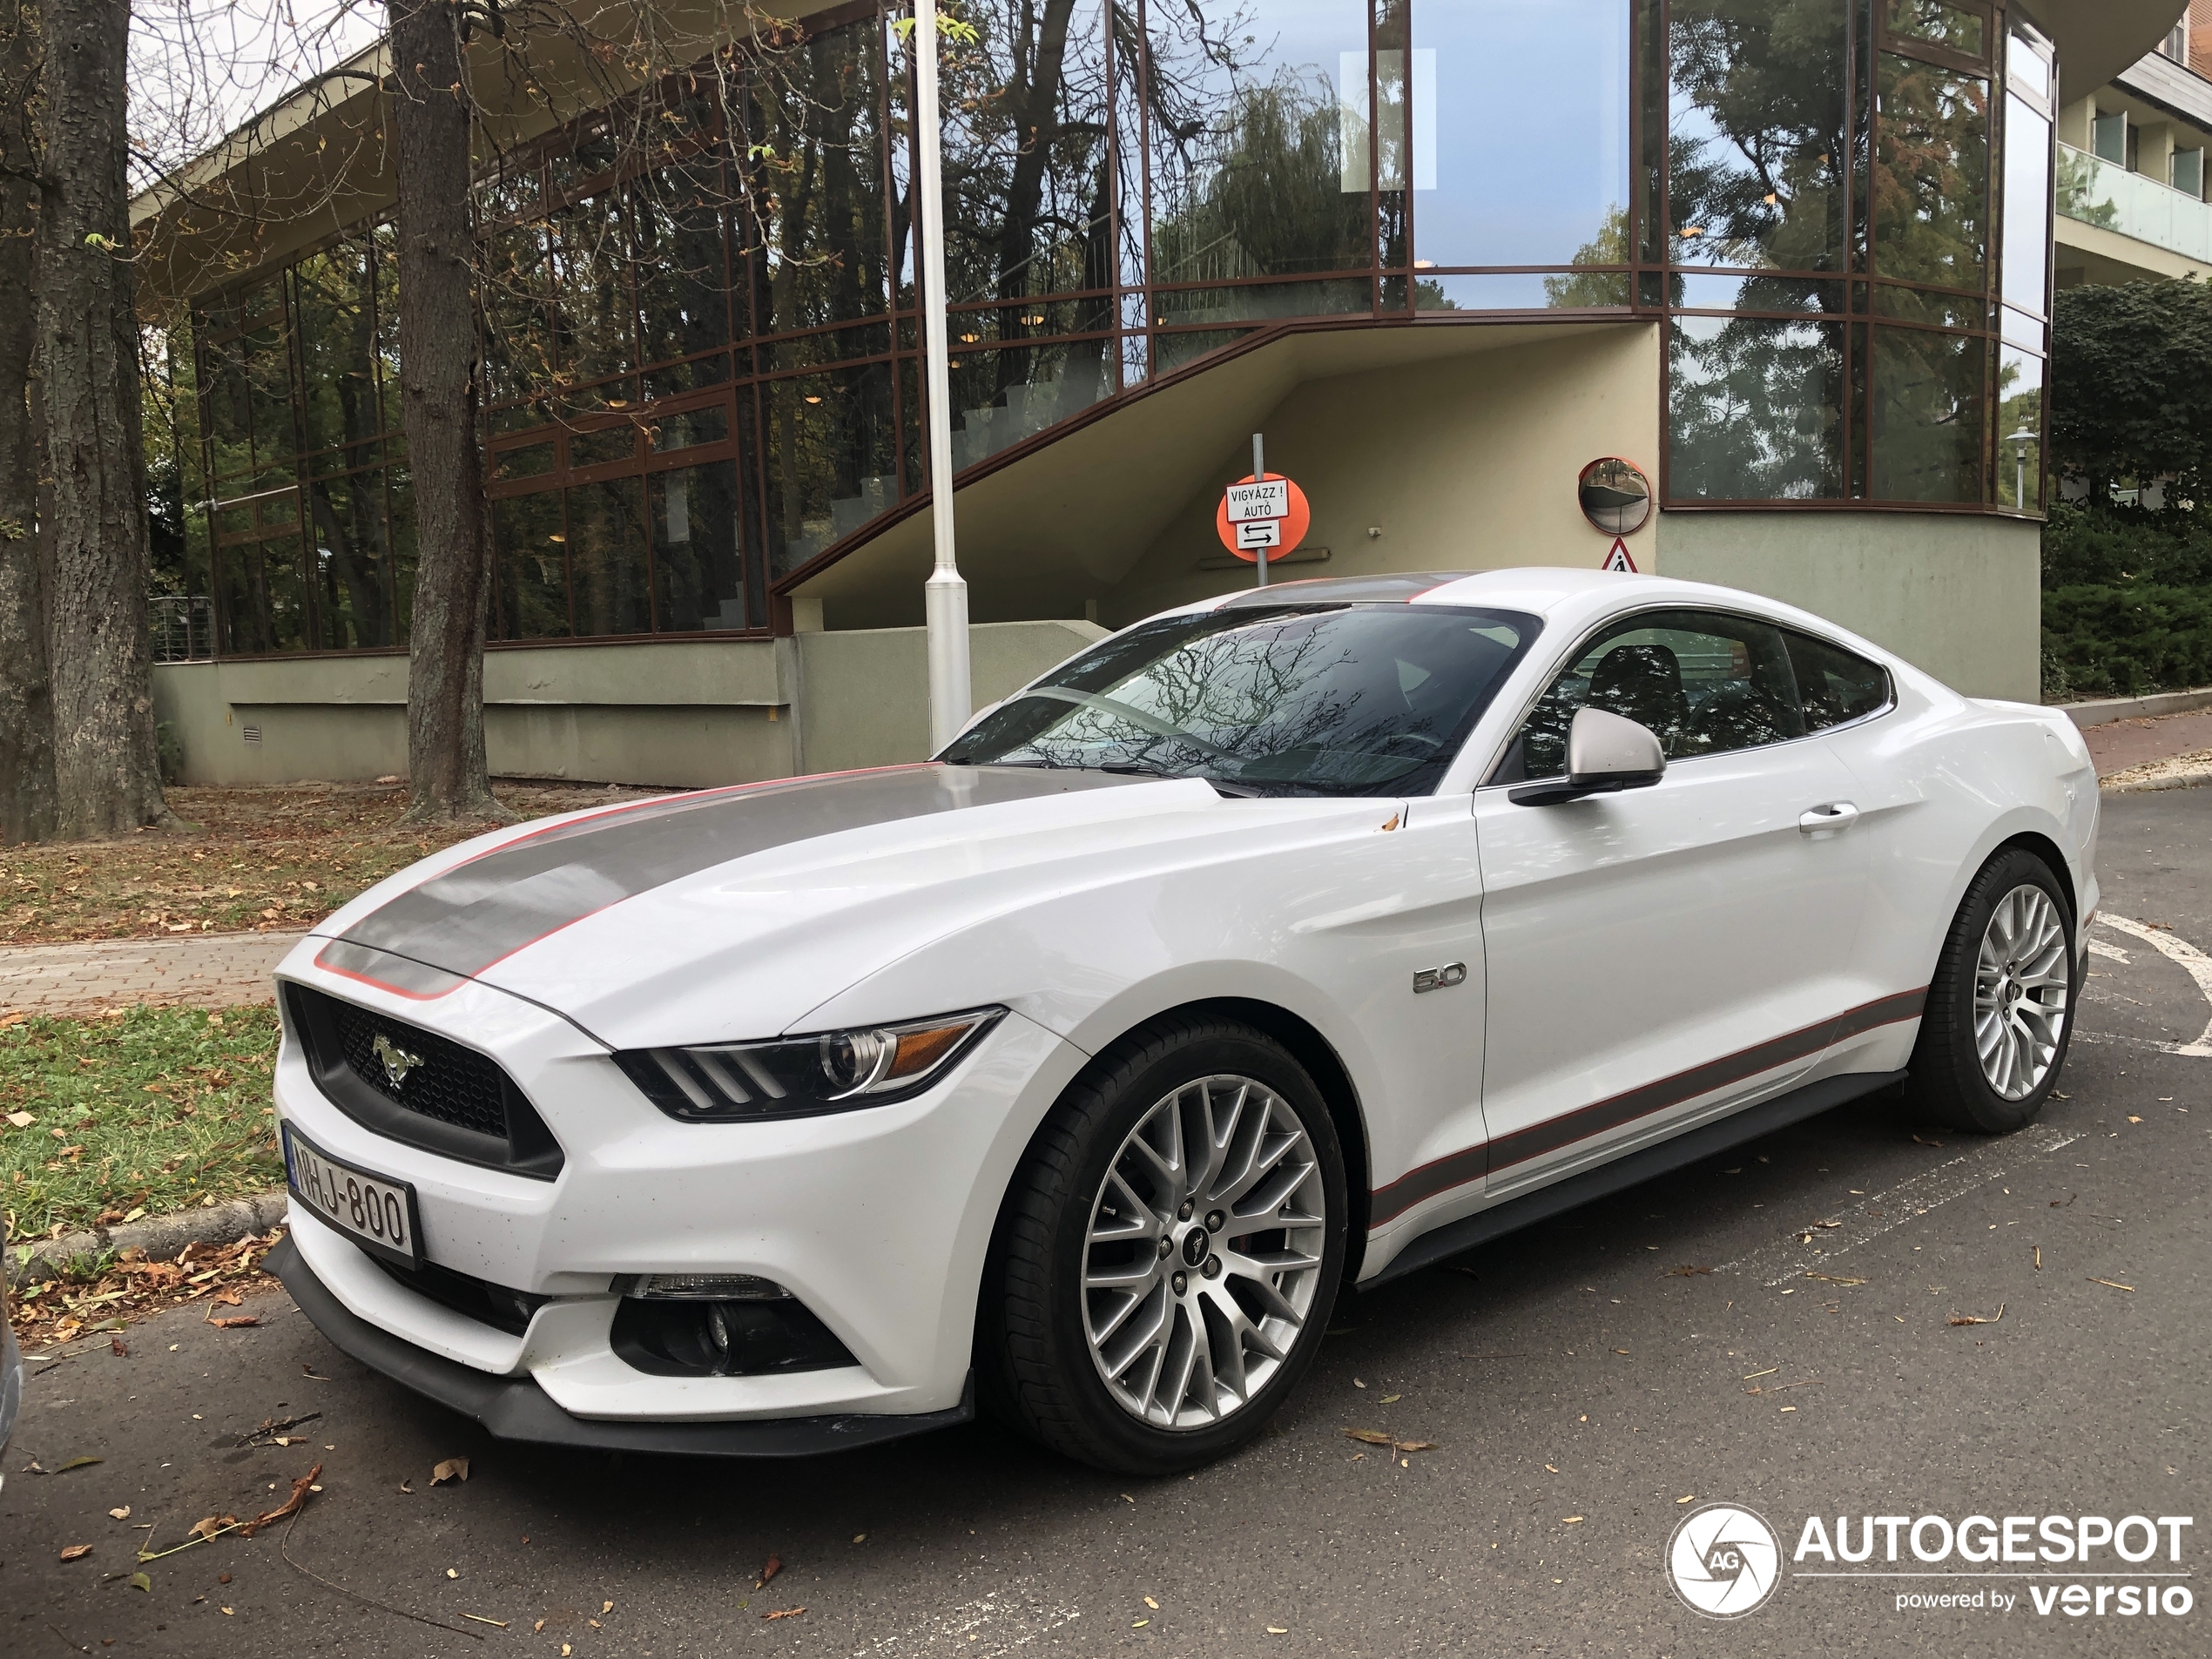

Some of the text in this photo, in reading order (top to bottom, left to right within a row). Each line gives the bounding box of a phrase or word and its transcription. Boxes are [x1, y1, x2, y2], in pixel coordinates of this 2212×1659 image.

[1231, 486, 1276, 502] VIGYÁZZ
[1244, 502, 1271, 517] AUTÓ
[1413, 961, 1467, 994] 5.0
[293, 1141, 404, 1246] NHJ-800
